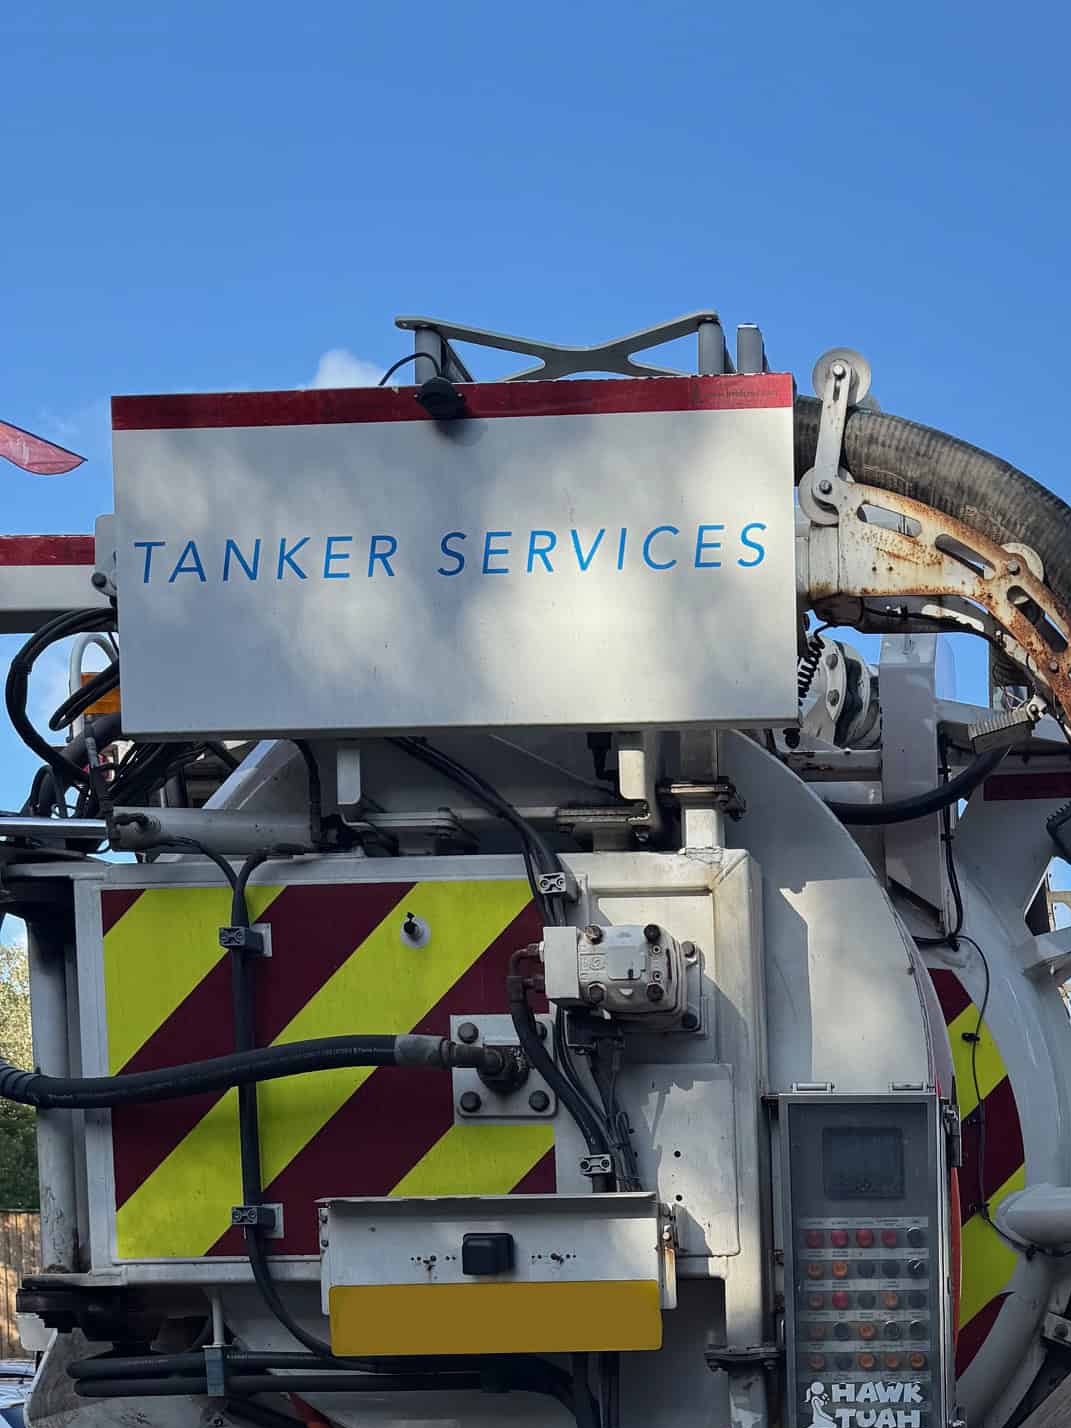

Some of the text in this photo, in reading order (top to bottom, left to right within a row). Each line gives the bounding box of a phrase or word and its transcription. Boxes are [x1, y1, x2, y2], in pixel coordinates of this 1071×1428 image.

[134, 522, 768, 585] TANKER SERVICES
[831, 1381, 924, 1404] HAWK
